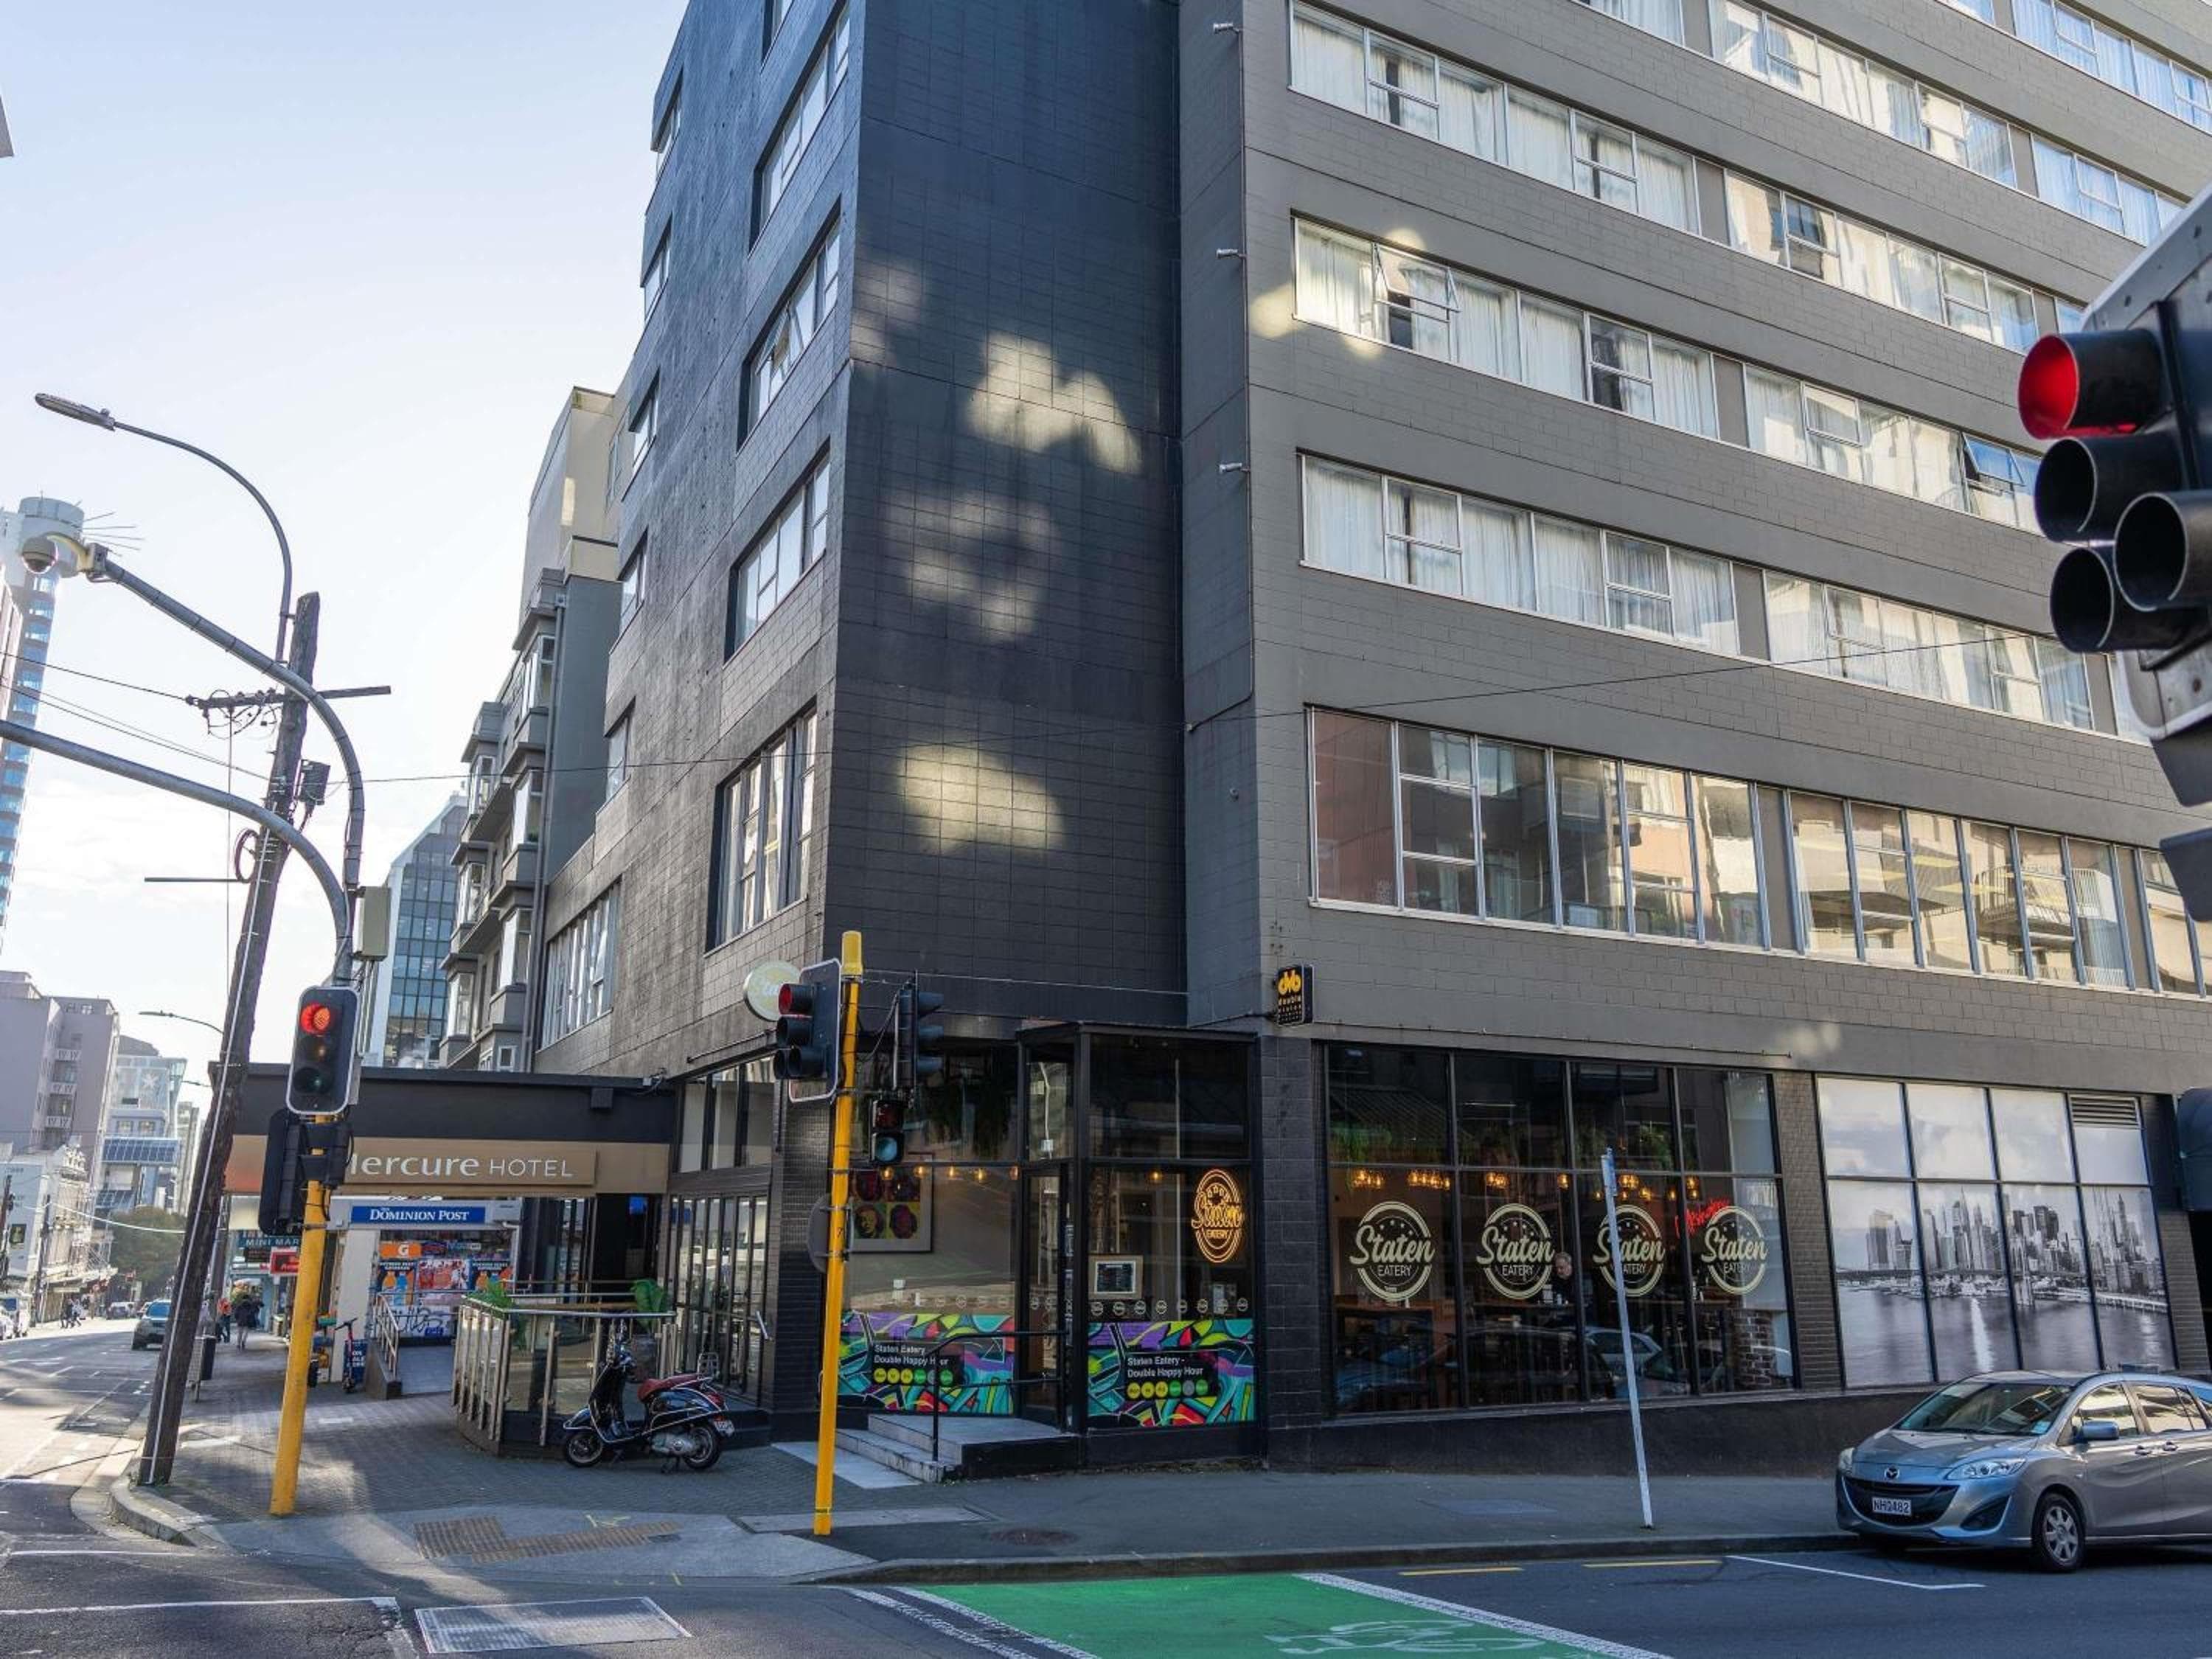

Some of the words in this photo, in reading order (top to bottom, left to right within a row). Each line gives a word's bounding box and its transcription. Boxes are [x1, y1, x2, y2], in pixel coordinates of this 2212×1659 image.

[489, 1158, 574, 1178] HOTEL
[438, 1210, 470, 1221] POST
[1349, 1225, 1436, 1265] Staten
[1476, 1226, 1555, 1265] Staten
[1593, 1226, 1666, 1263] Saten
[1701, 1227, 1768, 1262] Staten
[1377, 1265, 1412, 1276] EATERY
[1502, 1265, 1534, 1276] EATERY
[1623, 1263, 1646, 1275] ATERY
[1723, 1262, 1750, 1274] EATERY
[900, 1345, 925, 1355] Eatery
[874, 1356, 902, 1364] Double
[903, 1356, 928, 1366] Happy
[1155, 1356, 1180, 1366] Eatery
[1127, 1369, 1155, 1378] Double
[1157, 1368, 1183, 1378] Happy
[1184, 1367, 1203, 1376] Hour
